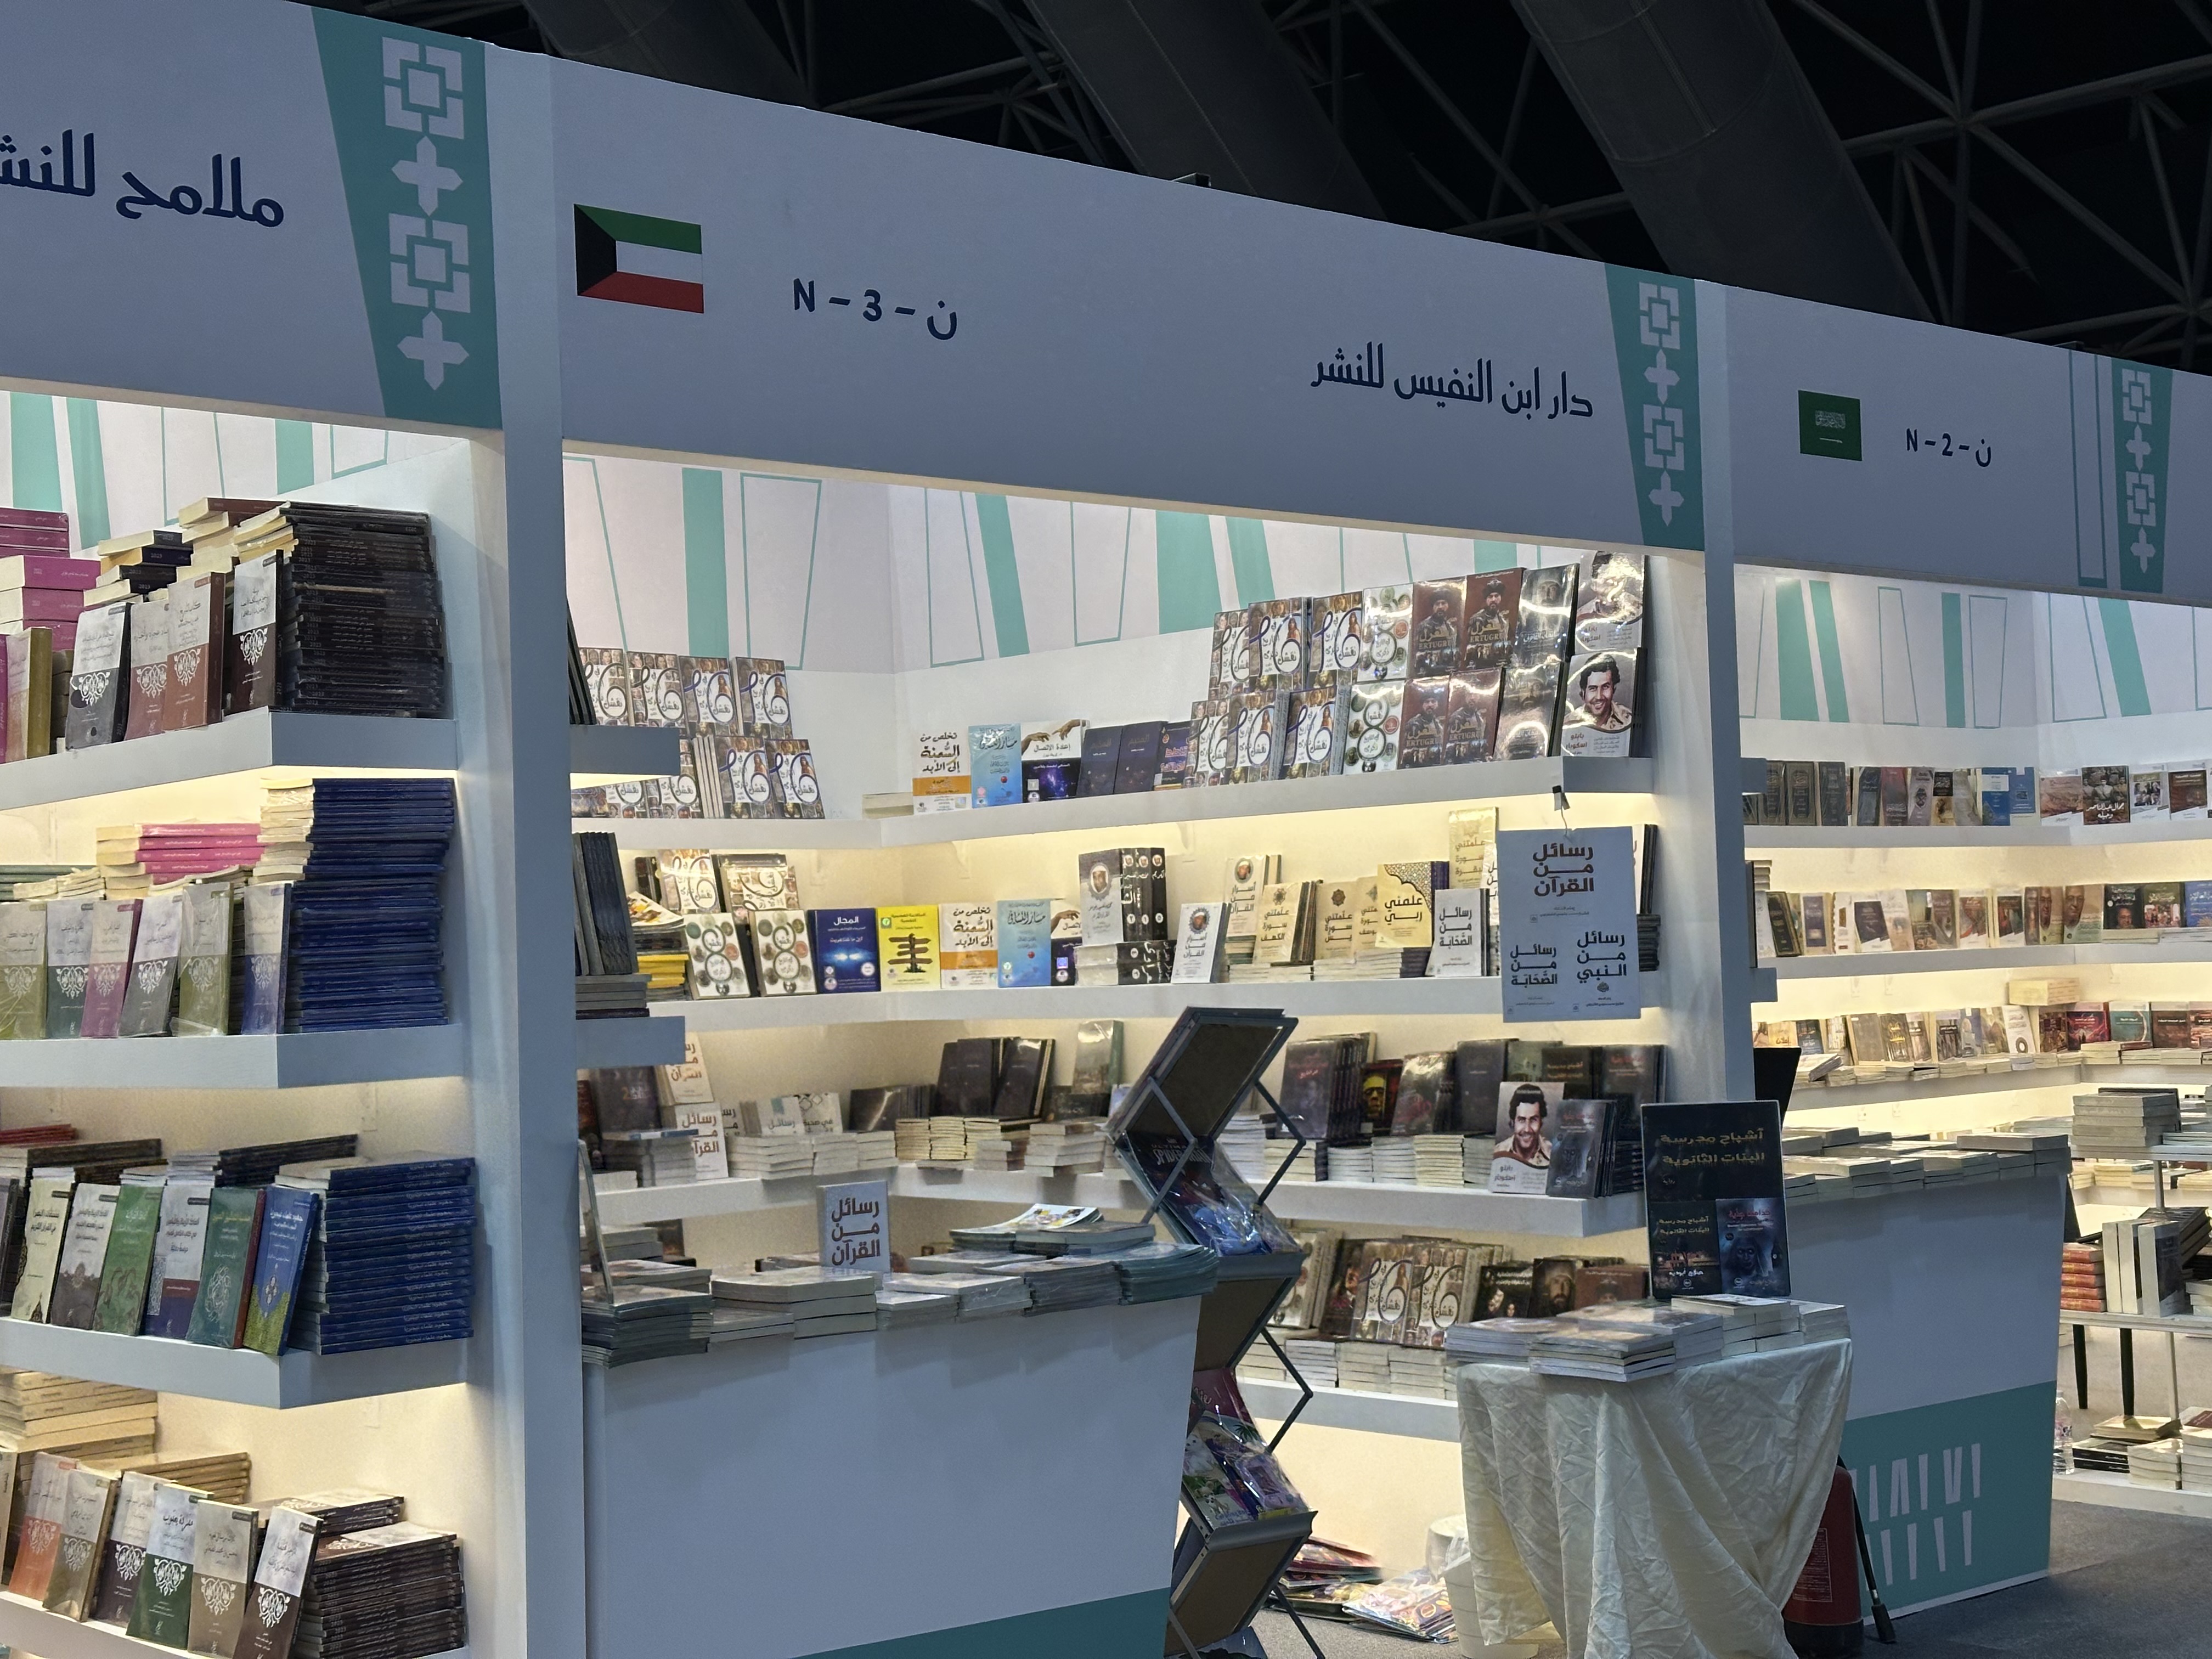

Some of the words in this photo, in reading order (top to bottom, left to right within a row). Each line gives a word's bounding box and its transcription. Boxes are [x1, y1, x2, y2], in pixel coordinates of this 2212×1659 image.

[0, 129, 95, 196] للنش
[116, 154, 284, 227] ملامح
[1311, 341, 1384, 387] للنشر
[1394, 358, 1492, 408] النفيس
[1502, 366, 1539, 420] ابن
[1548, 371, 1593, 420] دار
[1532, 843, 1594, 862] رسائل
[1533, 861, 1594, 878] من
[1534, 875, 1594, 897] القرآن
[1384, 895, 1423, 912] علمني
[833, 916, 859, 926] المجال
[1361, 917, 1378, 926] ورة
[1384, 912, 1423, 926] ربي
[1439, 906, 1472, 922] رسائل
[1439, 922, 1472, 933] من
[1576, 930, 1626, 948] رسائل
[1510, 943, 1556, 958] رسائل
[1576, 949, 1626, 964] من
[1510, 958, 1557, 972] من
[1577, 964, 1627, 984] النبي
[693, 1128, 719, 1138] م
[693, 1141, 719, 1158] القرآ
[831, 1197, 880, 1222] رسائل
[831, 1222, 880, 1242] من
[832, 1239, 881, 1266] القرآن
